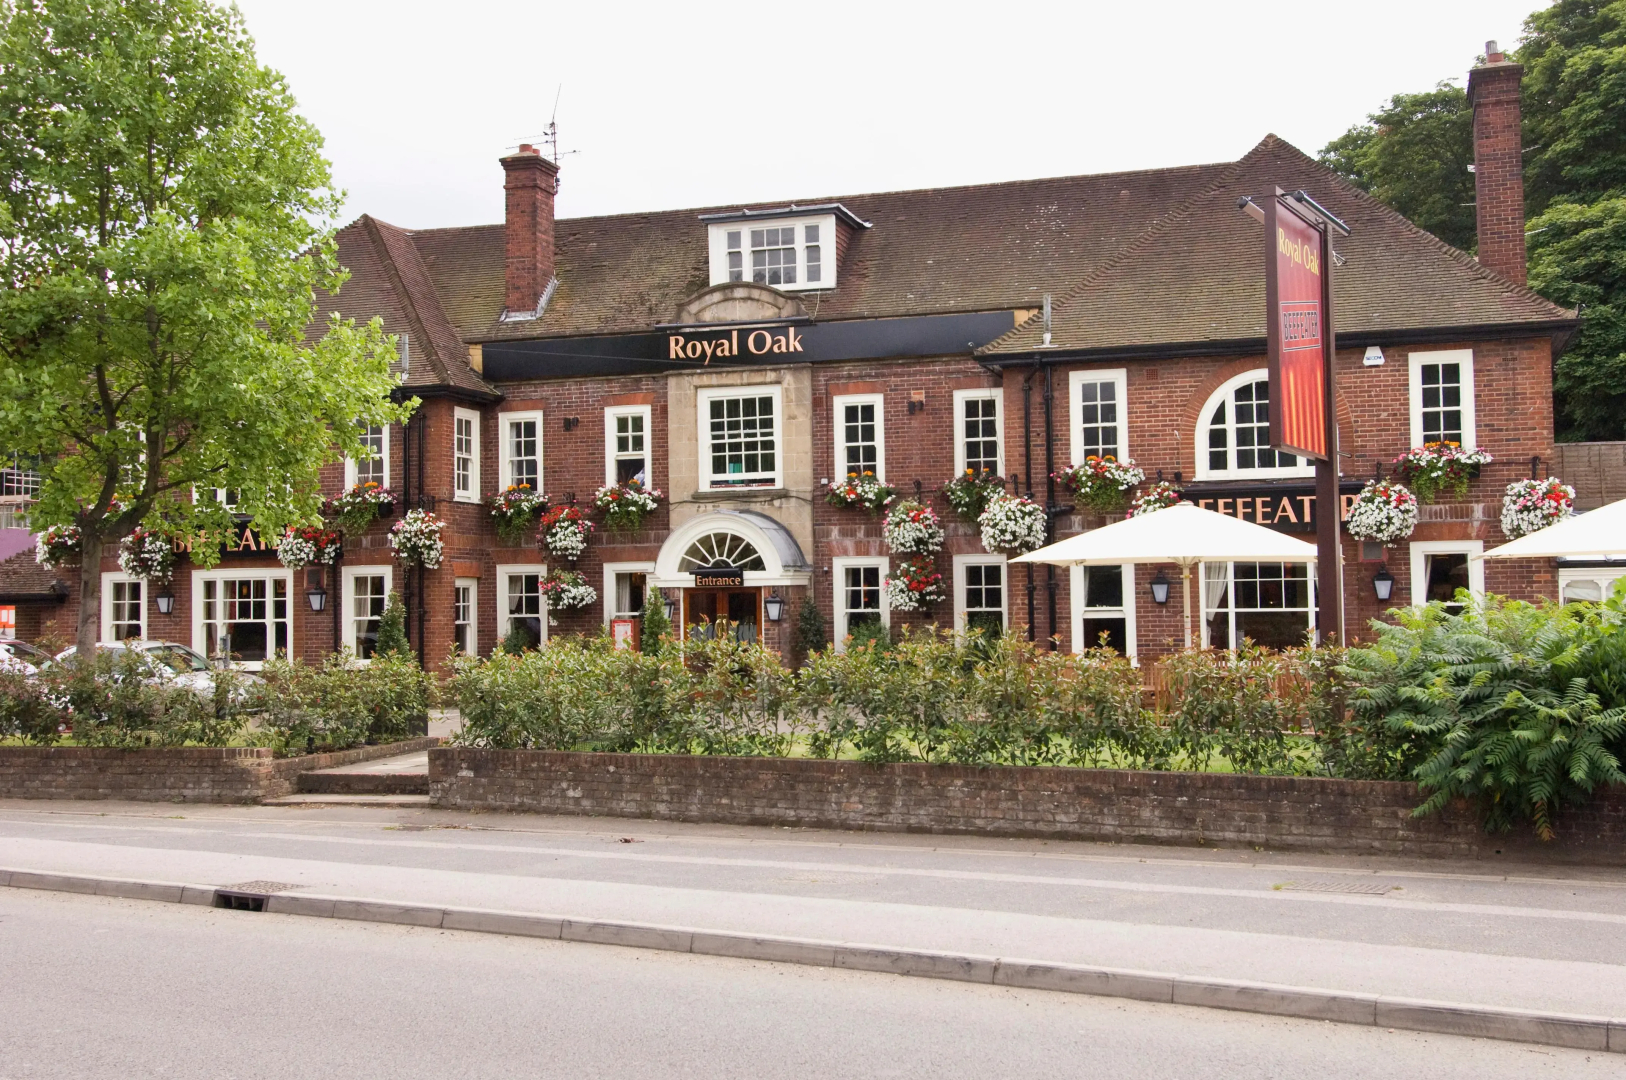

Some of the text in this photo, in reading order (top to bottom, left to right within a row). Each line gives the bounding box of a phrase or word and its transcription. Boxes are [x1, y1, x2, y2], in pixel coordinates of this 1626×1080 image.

[1278, 227, 1320, 276] Royal Oak
[1282, 310, 1320, 342] BEEFEATER
[669, 326, 804, 366] Royal Oak
[696, 575, 741, 586] Entrance
